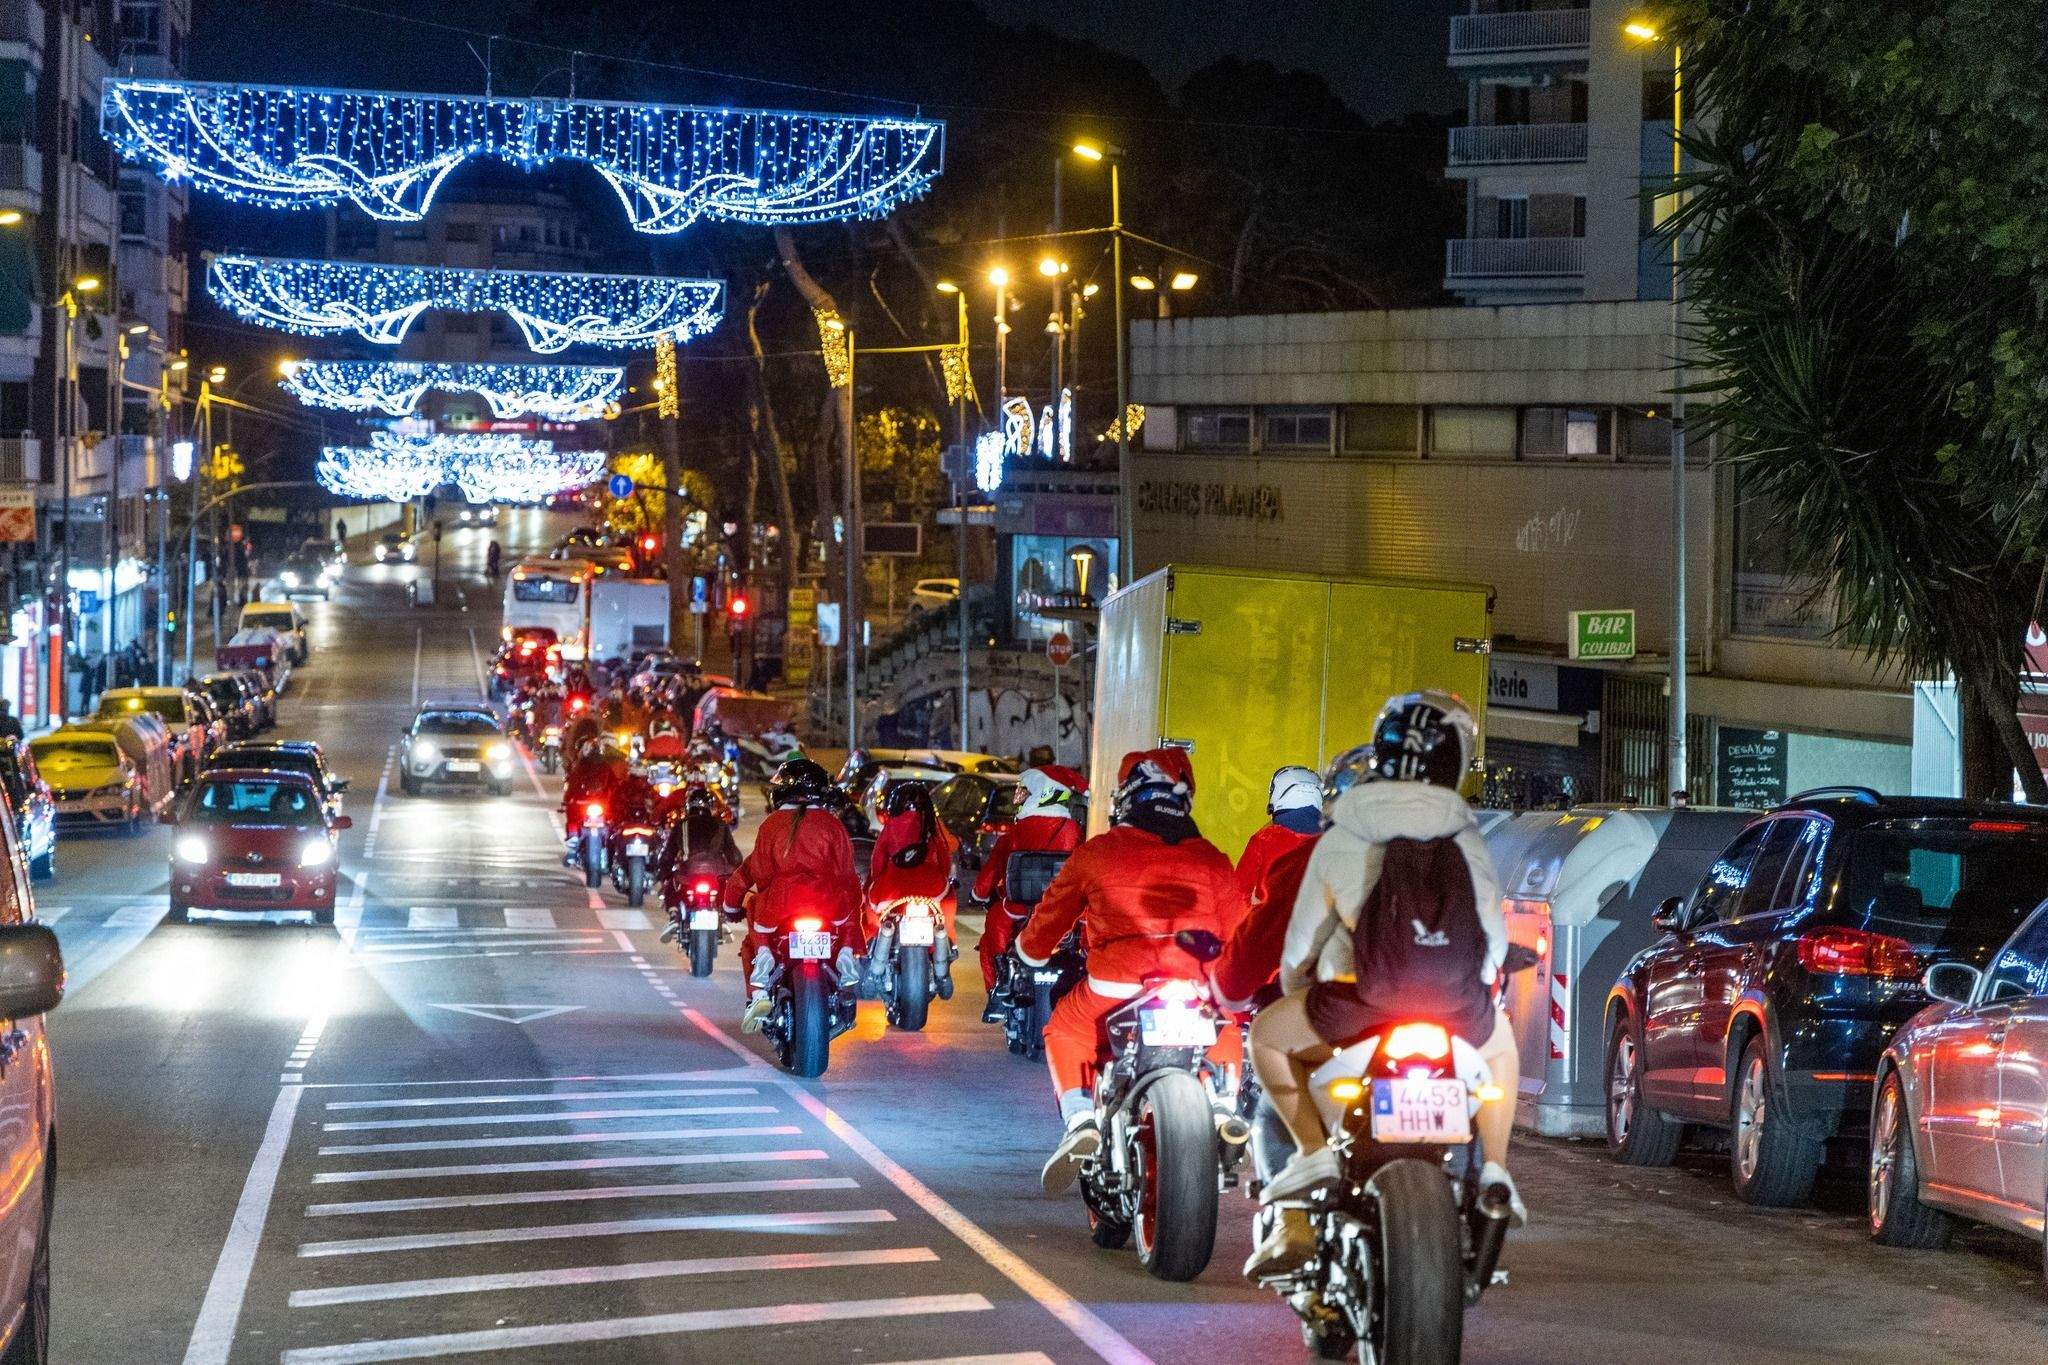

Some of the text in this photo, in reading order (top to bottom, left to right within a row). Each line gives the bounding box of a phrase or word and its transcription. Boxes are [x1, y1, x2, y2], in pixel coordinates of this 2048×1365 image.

[1587, 616, 1626, 635] BAR
[799, 933, 829, 945] 6236
[803, 946, 825, 956] LLV
[1400, 1085, 1461, 1107] 4453
[1400, 1109, 1445, 1131] HHW
